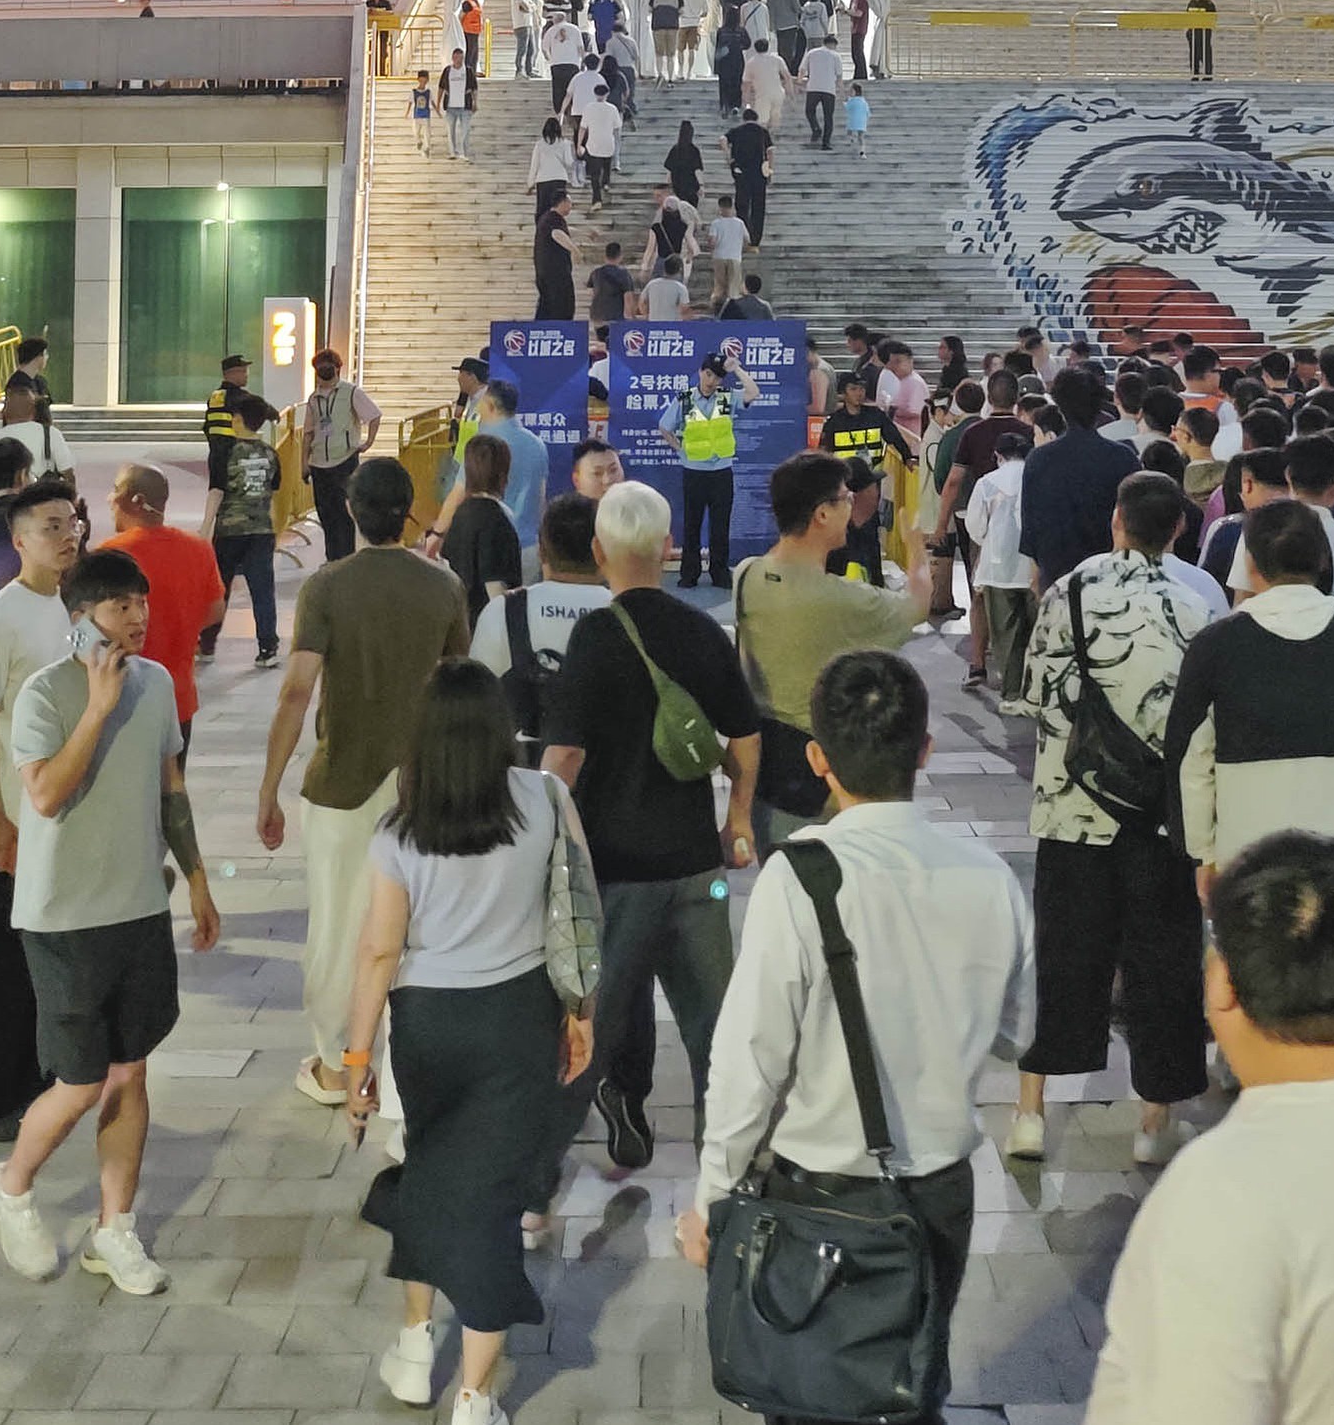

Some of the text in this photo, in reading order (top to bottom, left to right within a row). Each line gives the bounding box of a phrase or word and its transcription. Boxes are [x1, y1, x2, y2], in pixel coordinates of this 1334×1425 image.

[273, 311, 296, 347] 2
[630, 375, 688, 392] 2号扶梯
[626, 394, 671, 410] 检票入
[540, 605, 593, 619] ISHAR
